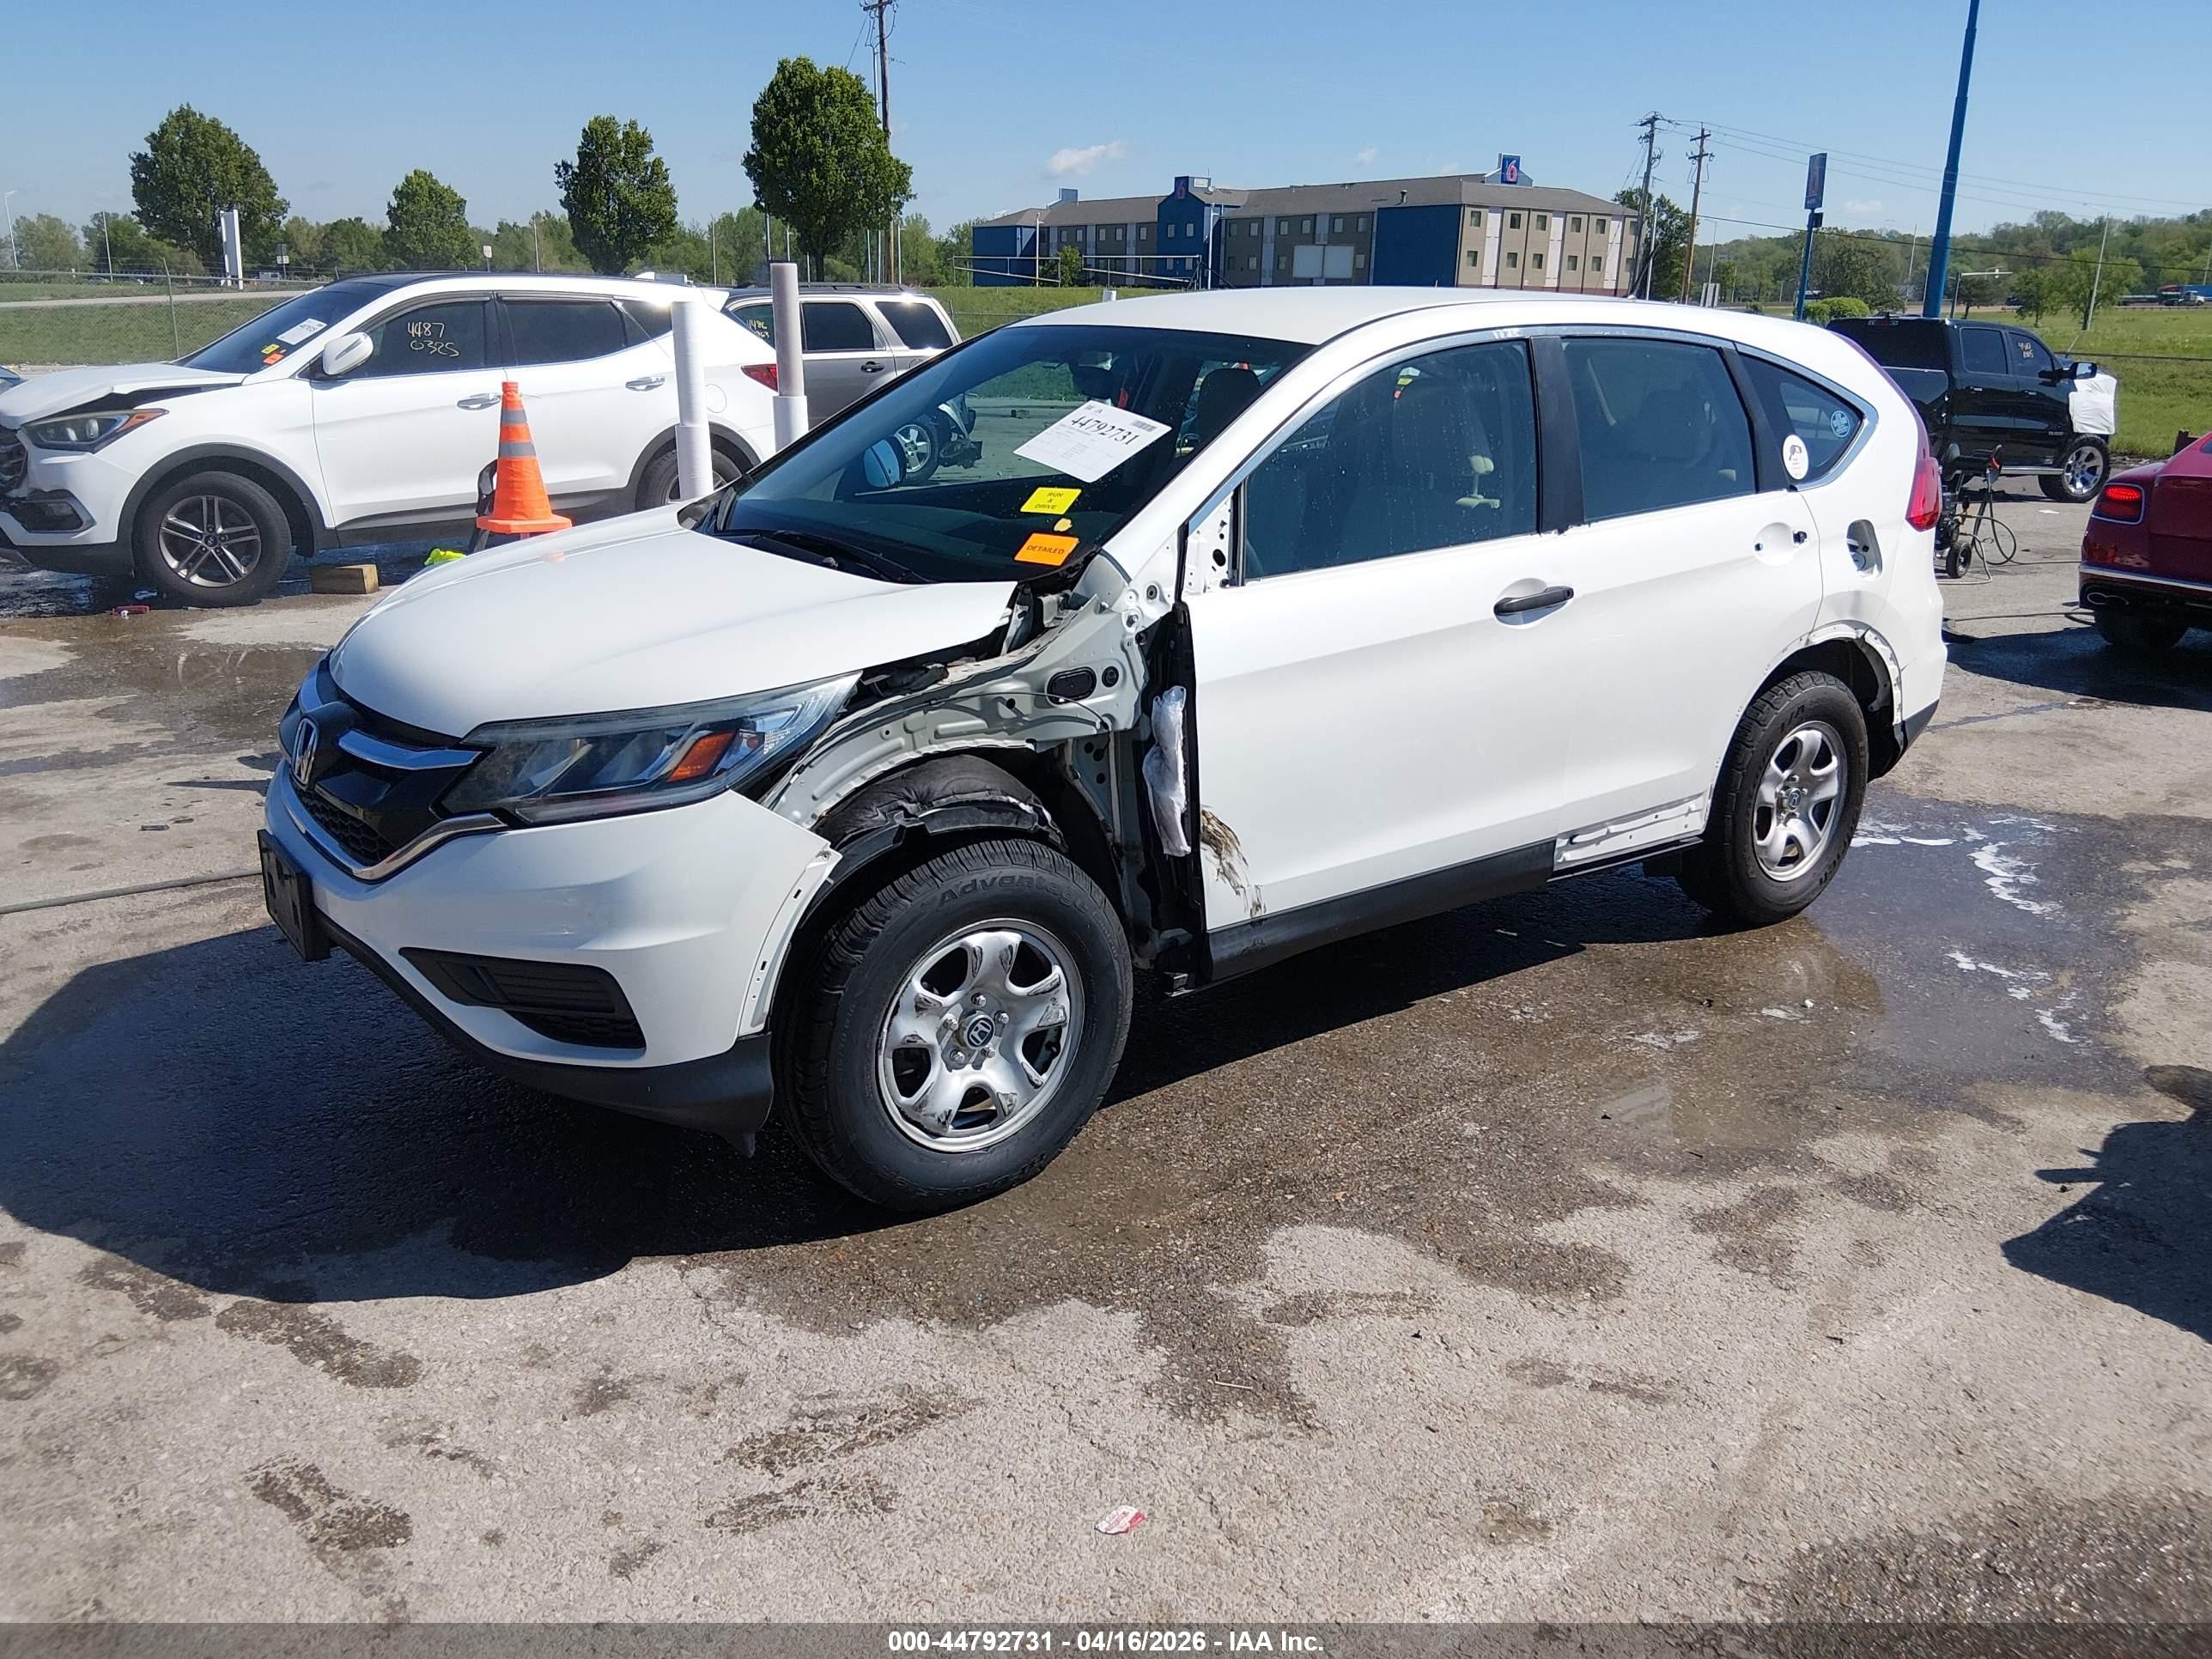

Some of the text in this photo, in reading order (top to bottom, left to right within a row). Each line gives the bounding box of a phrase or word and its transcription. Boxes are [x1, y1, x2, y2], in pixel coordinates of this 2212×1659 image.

[1505, 160, 1517, 182] 6
[407, 321, 446, 338] 4487
[410, 340, 460, 357] 0325
[1071, 416, 1140, 446] 44792731
[1025, 544, 1066, 556] DETAILED
[939, 872, 1088, 913] Advantage
